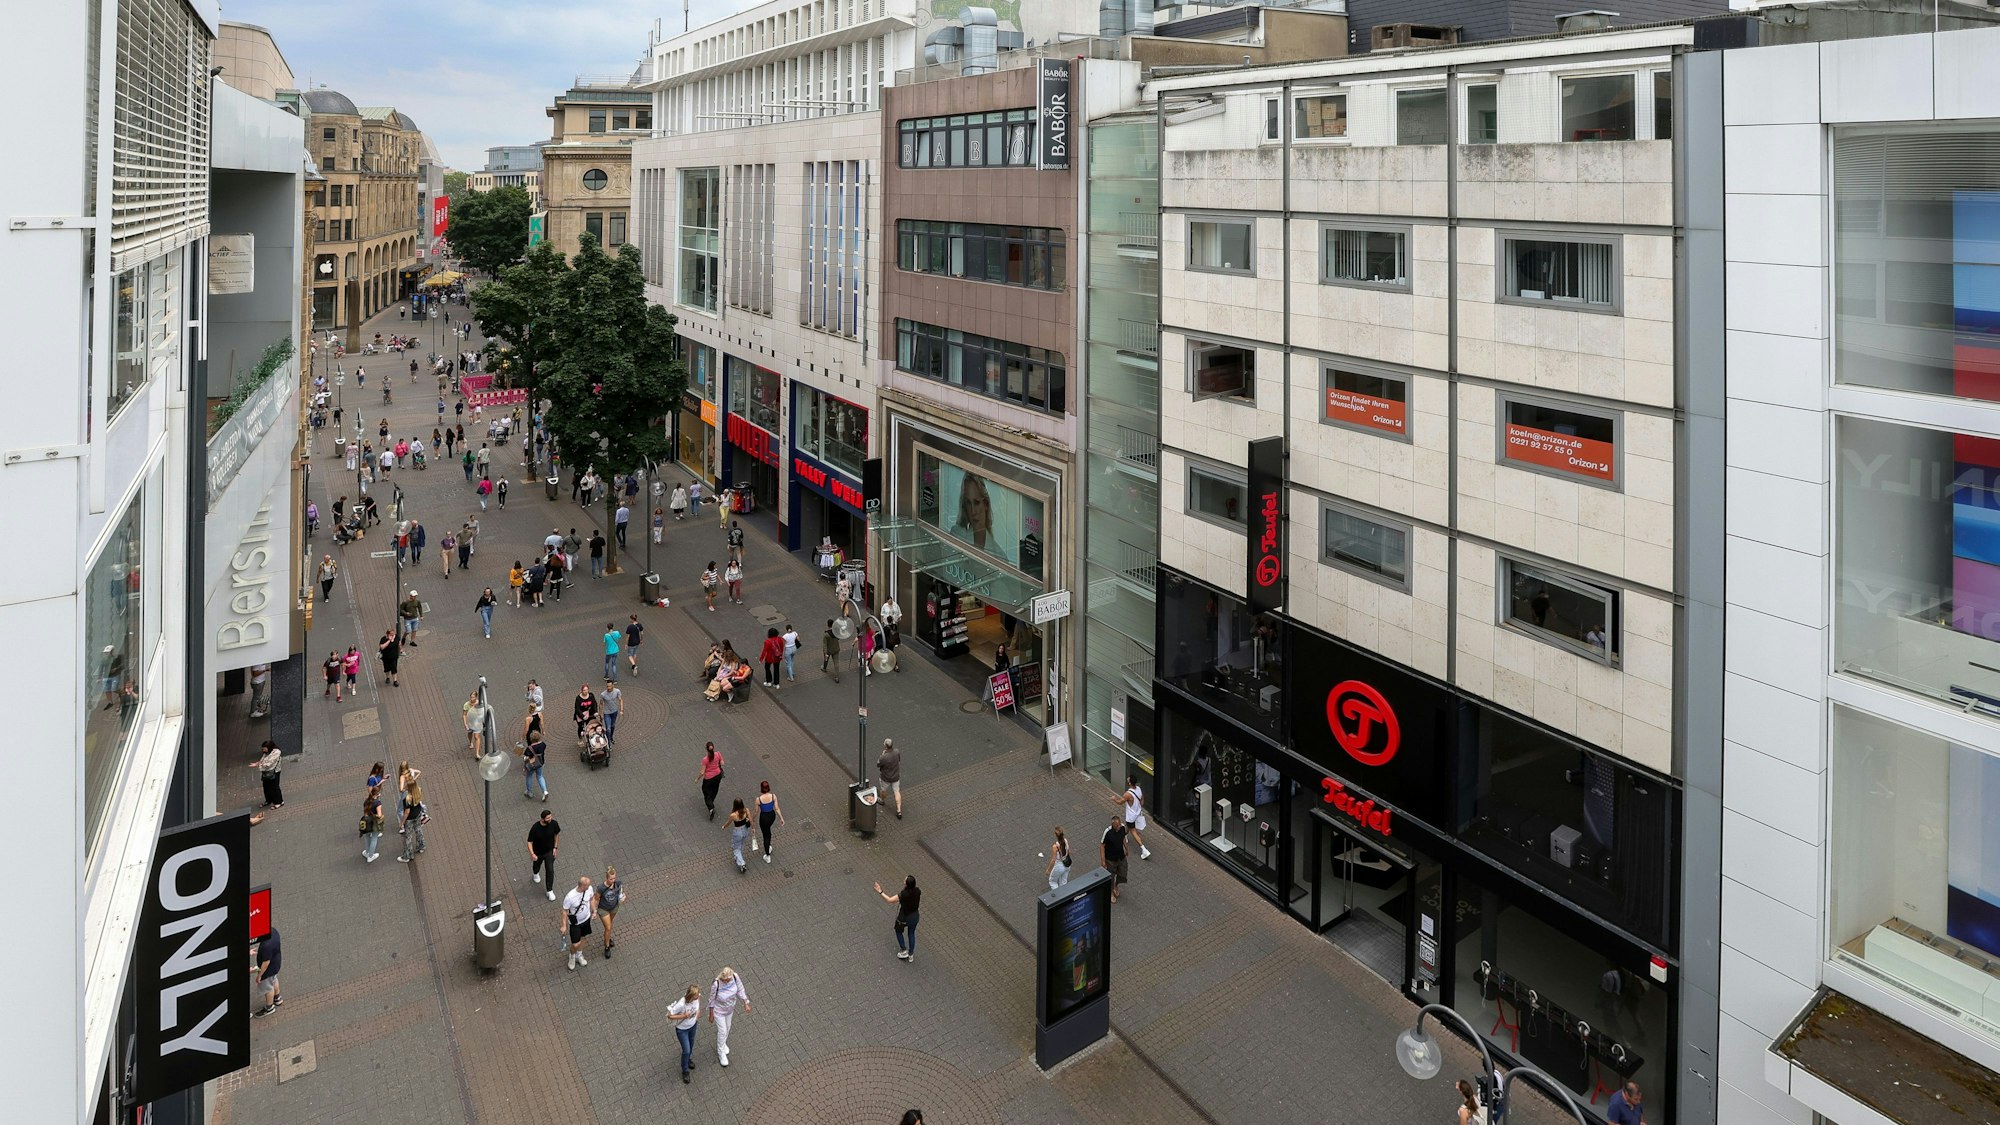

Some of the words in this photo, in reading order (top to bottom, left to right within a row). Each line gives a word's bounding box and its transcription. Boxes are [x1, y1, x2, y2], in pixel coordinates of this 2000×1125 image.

[1044, 67, 1068, 78] BABOR
[1050, 93, 1068, 157] BABOR
[1330, 391, 1351, 402] Orizon
[1351, 395, 1371, 406] findet
[1372, 400, 1389, 410] Ihren
[1330, 399, 1367, 413] Wunschjob.
[1373, 414, 1394, 426] Orizon
[1510, 427, 1583, 449] koeln@orizon.de
[1510, 436, 1529, 446] 0221
[1530, 439, 1541, 449] 92
[1542, 441, 1552, 451] 57
[1554, 444, 1565, 454] 55
[1566, 448, 1573, 456] 0
[794, 458, 827, 488] TALLY
[1568, 457, 1598, 470] Orizon
[1262, 491, 1279, 553] Teufel
[1037, 598, 1069, 616] BABOR
[994, 682, 1009, 695] SALE
[1321, 776, 1392, 836] Teufel
[159, 843, 230, 1057] ONLY
